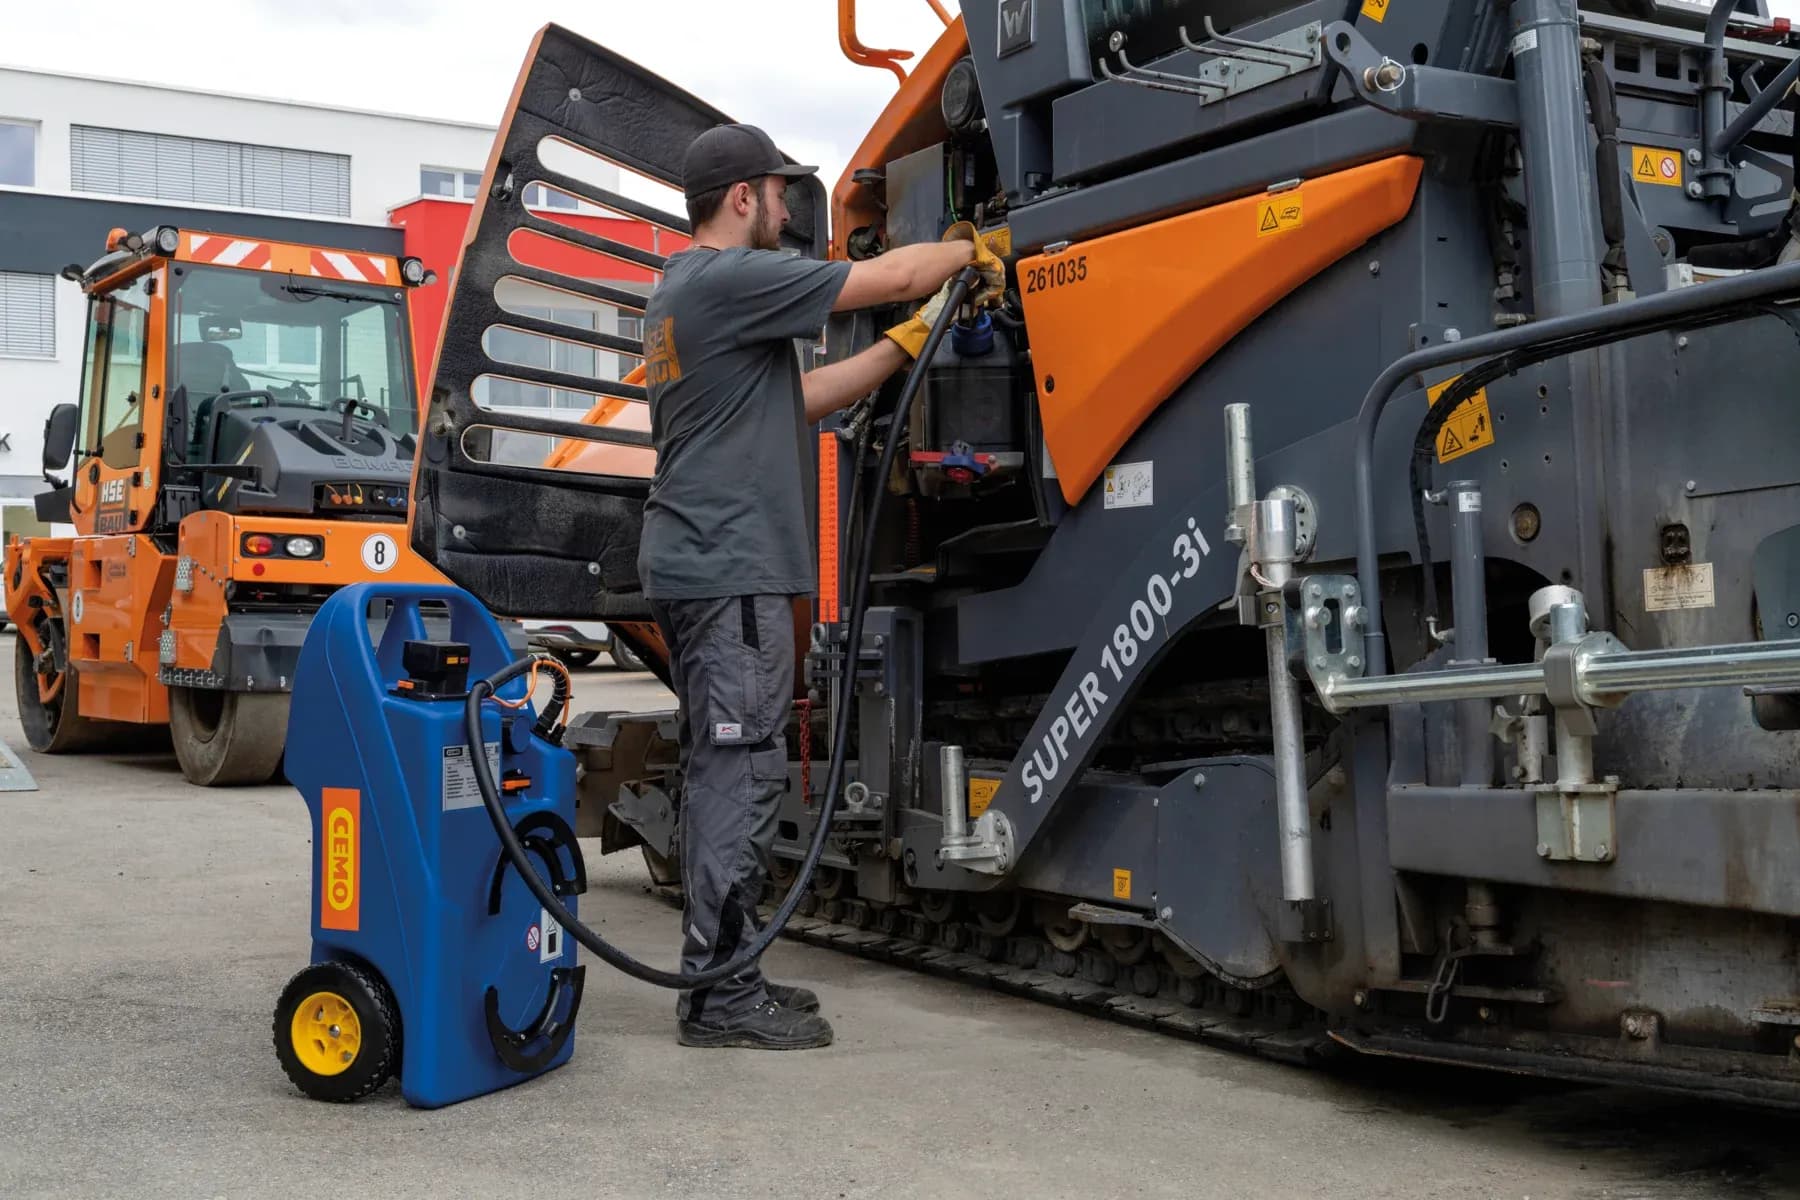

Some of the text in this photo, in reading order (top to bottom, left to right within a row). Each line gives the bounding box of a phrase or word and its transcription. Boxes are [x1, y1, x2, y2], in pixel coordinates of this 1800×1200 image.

[1027, 255, 1088, 294] 261035
[102, 479, 125, 503] HSE
[374, 540, 385, 565] 8
[1021, 516, 1211, 804] SUPER 1800-3i
[332, 816, 349, 904] CEMO
